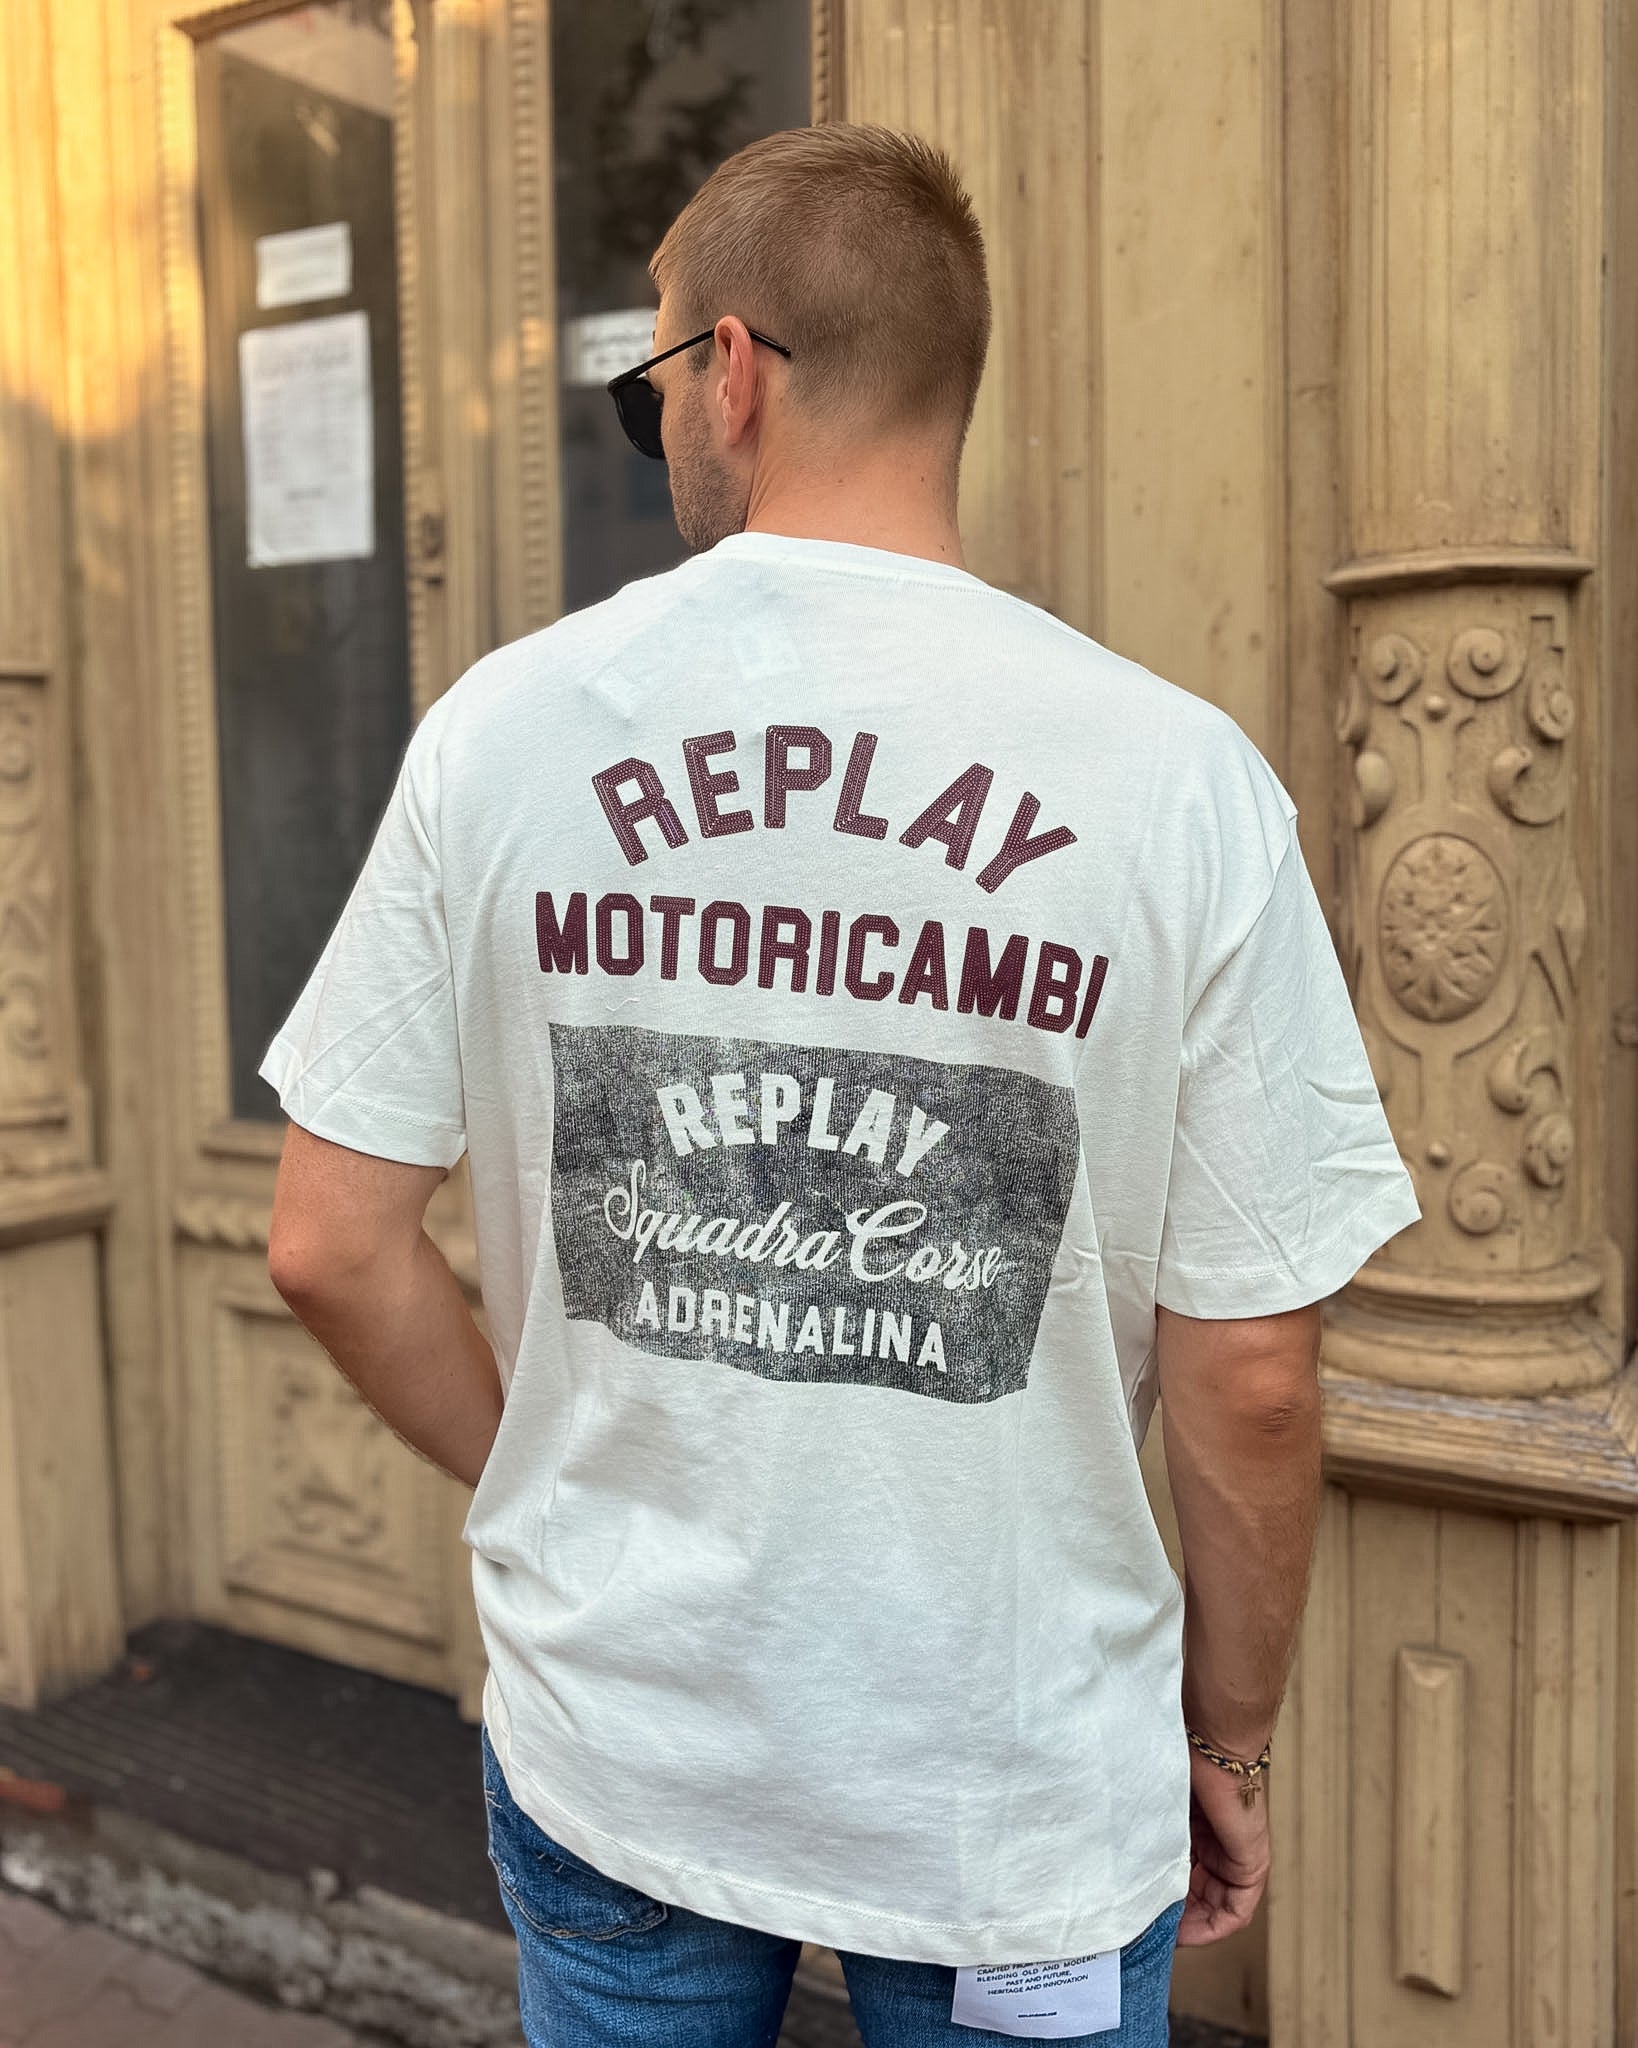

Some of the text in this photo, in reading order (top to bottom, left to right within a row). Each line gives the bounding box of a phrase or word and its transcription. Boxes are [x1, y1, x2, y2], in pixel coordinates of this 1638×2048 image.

[591, 725, 1077, 893] REPLAY
[535, 891, 1109, 1039] MOTORICAMBI
[656, 1073, 950, 1178] REPLAY
[603, 1158, 1003, 1291] Squadra Corse
[635, 1281, 947, 1373] ADRENALINA
[977, 1964, 1010, 1975] CRAFTED
[977, 1972, 1018, 1982] BLENDING
[1022, 1968, 1039, 1976] OLD
[1042, 1963, 1060, 1972] AND
[988, 1974, 1089, 1995] HERITAGE AND INNOVATION
[1006, 1978, 1023, 1986] PAST
[1025, 1975, 1041, 1983] AND
